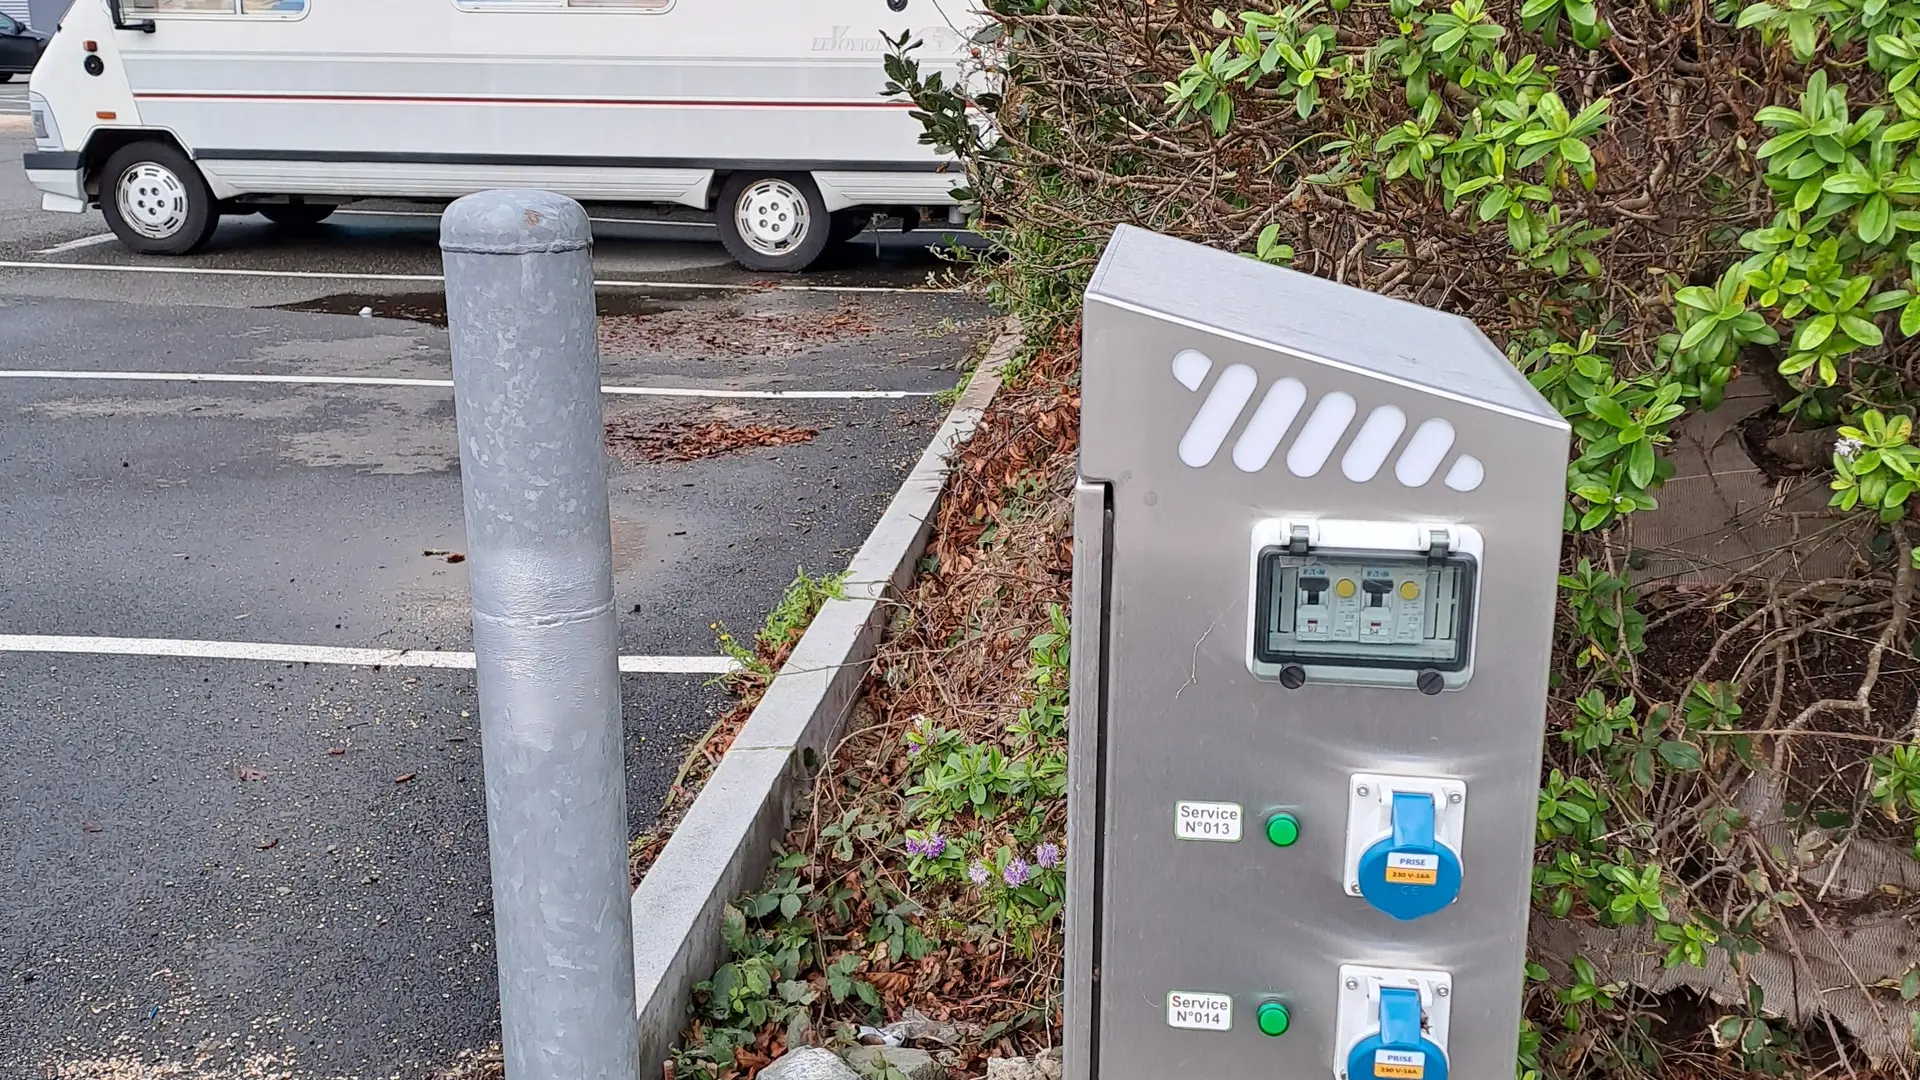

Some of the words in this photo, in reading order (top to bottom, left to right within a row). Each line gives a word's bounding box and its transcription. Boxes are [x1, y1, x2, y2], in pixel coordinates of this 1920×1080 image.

[1181, 805, 1238, 820] Service
[1185, 821, 1230, 835] N°013
[1399, 858, 1427, 866] PRISE
[1172, 995, 1229, 1010] Service
[1176, 1010, 1221, 1025] N°014
[1387, 1055, 1413, 1063] PRISE
